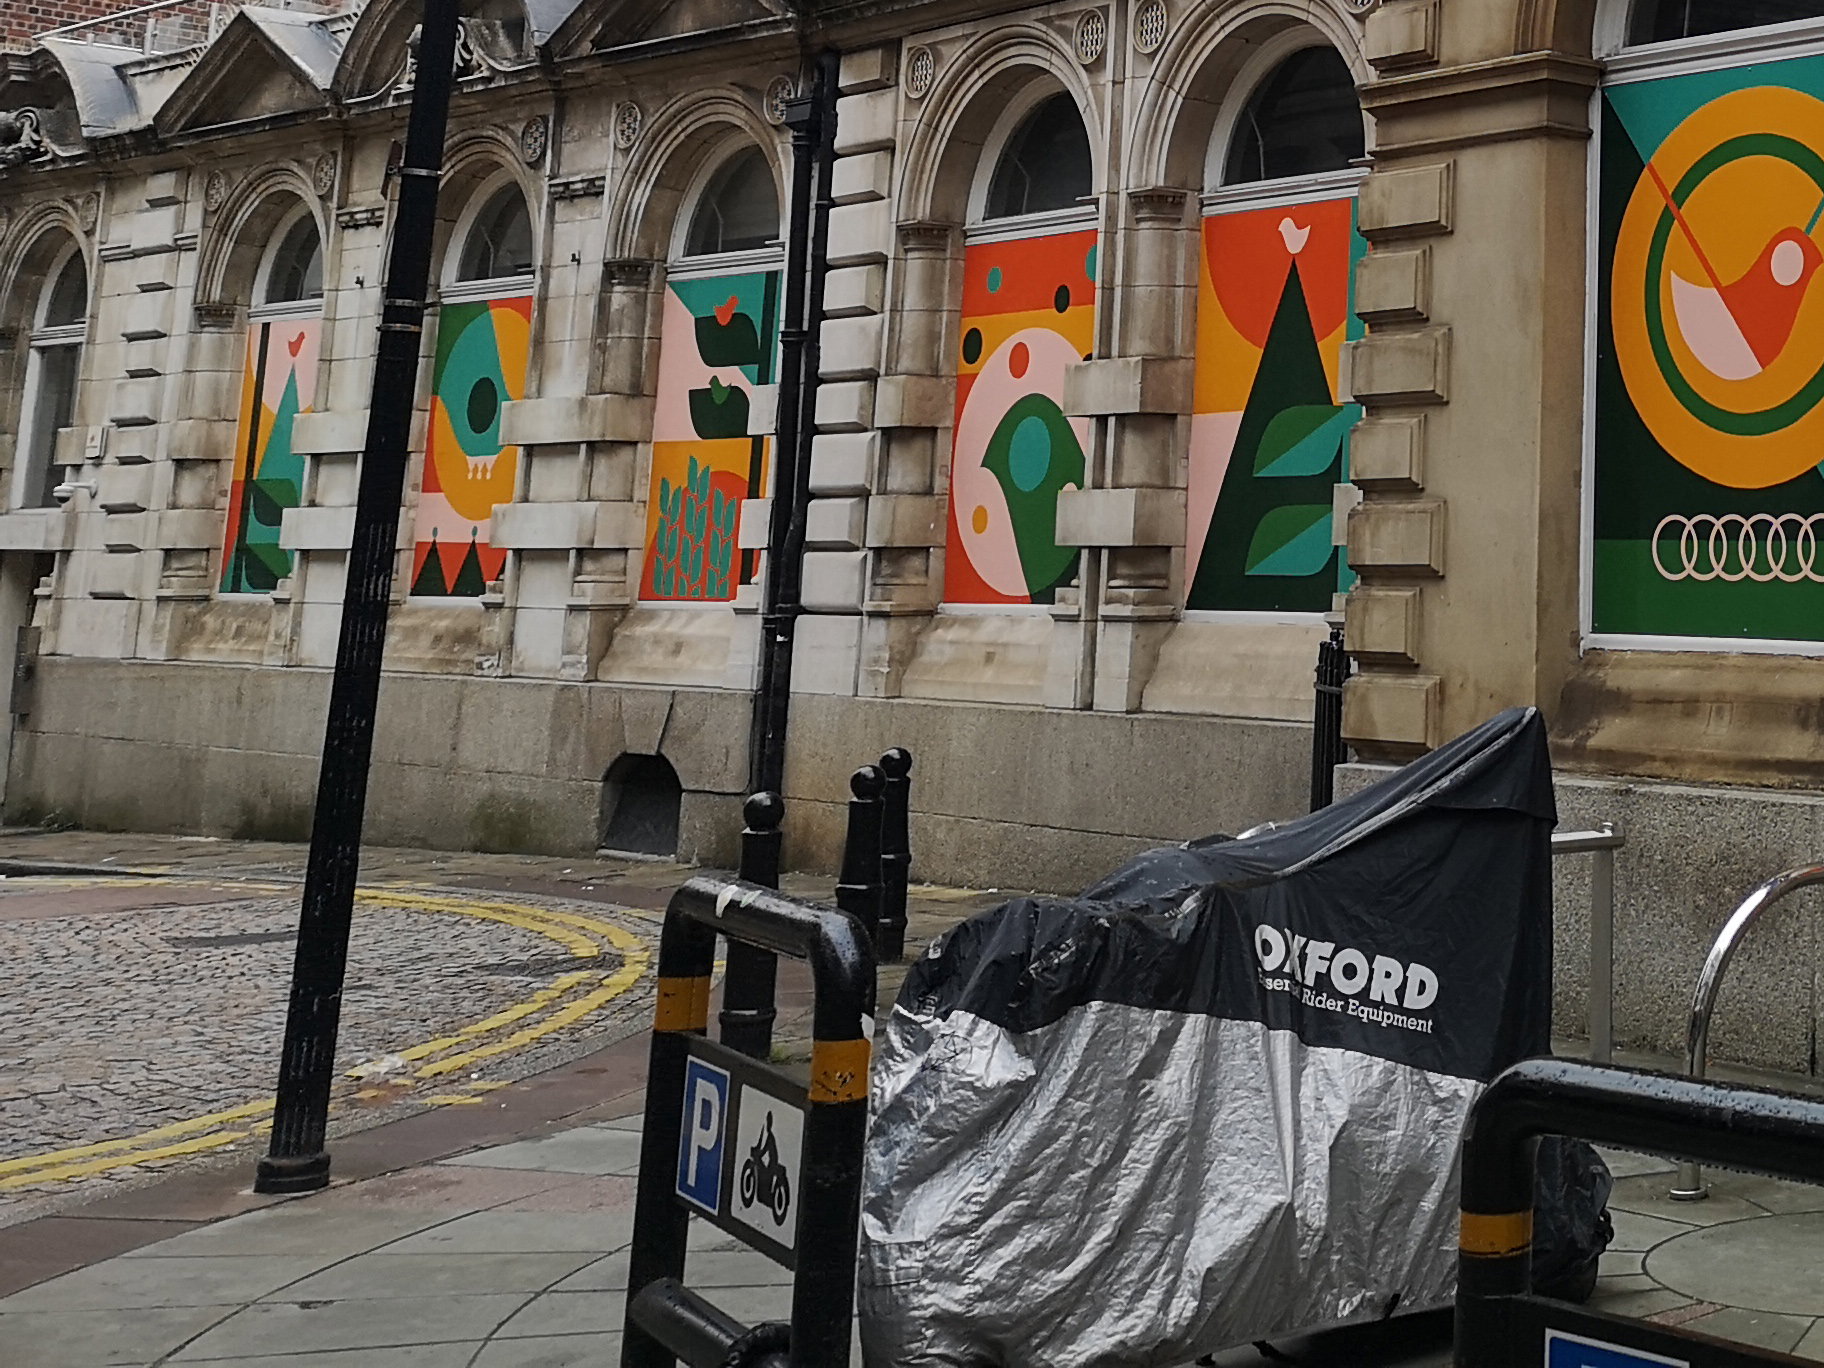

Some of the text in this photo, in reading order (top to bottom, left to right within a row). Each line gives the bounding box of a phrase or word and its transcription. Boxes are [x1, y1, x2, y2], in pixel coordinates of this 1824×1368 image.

[1254, 923, 1439, 1010] OXFORD
[1301, 986, 1433, 1034] Rider Equipment
[686, 1077, 720, 1188] P
